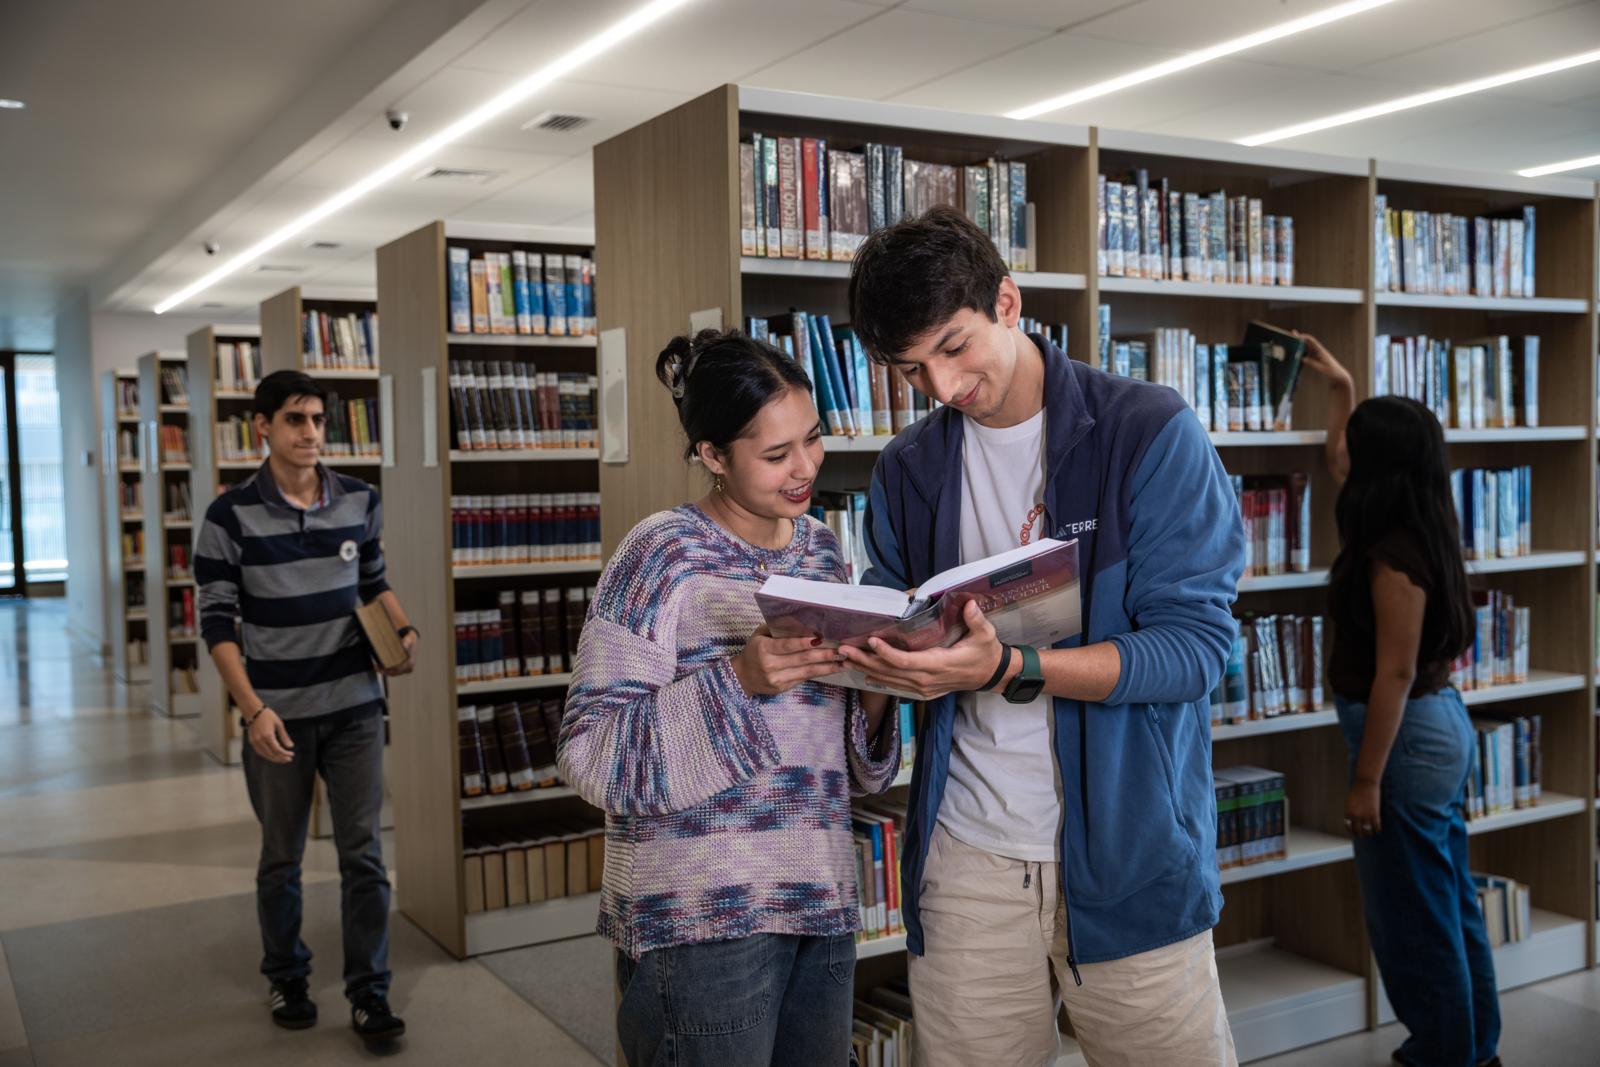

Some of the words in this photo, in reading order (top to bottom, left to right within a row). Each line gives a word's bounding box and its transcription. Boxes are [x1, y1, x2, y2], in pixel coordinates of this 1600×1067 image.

[1020, 503, 1044, 546] OLCO
[993, 578, 1047, 600] CONTROL
[1004, 583, 1051, 604] PODER
